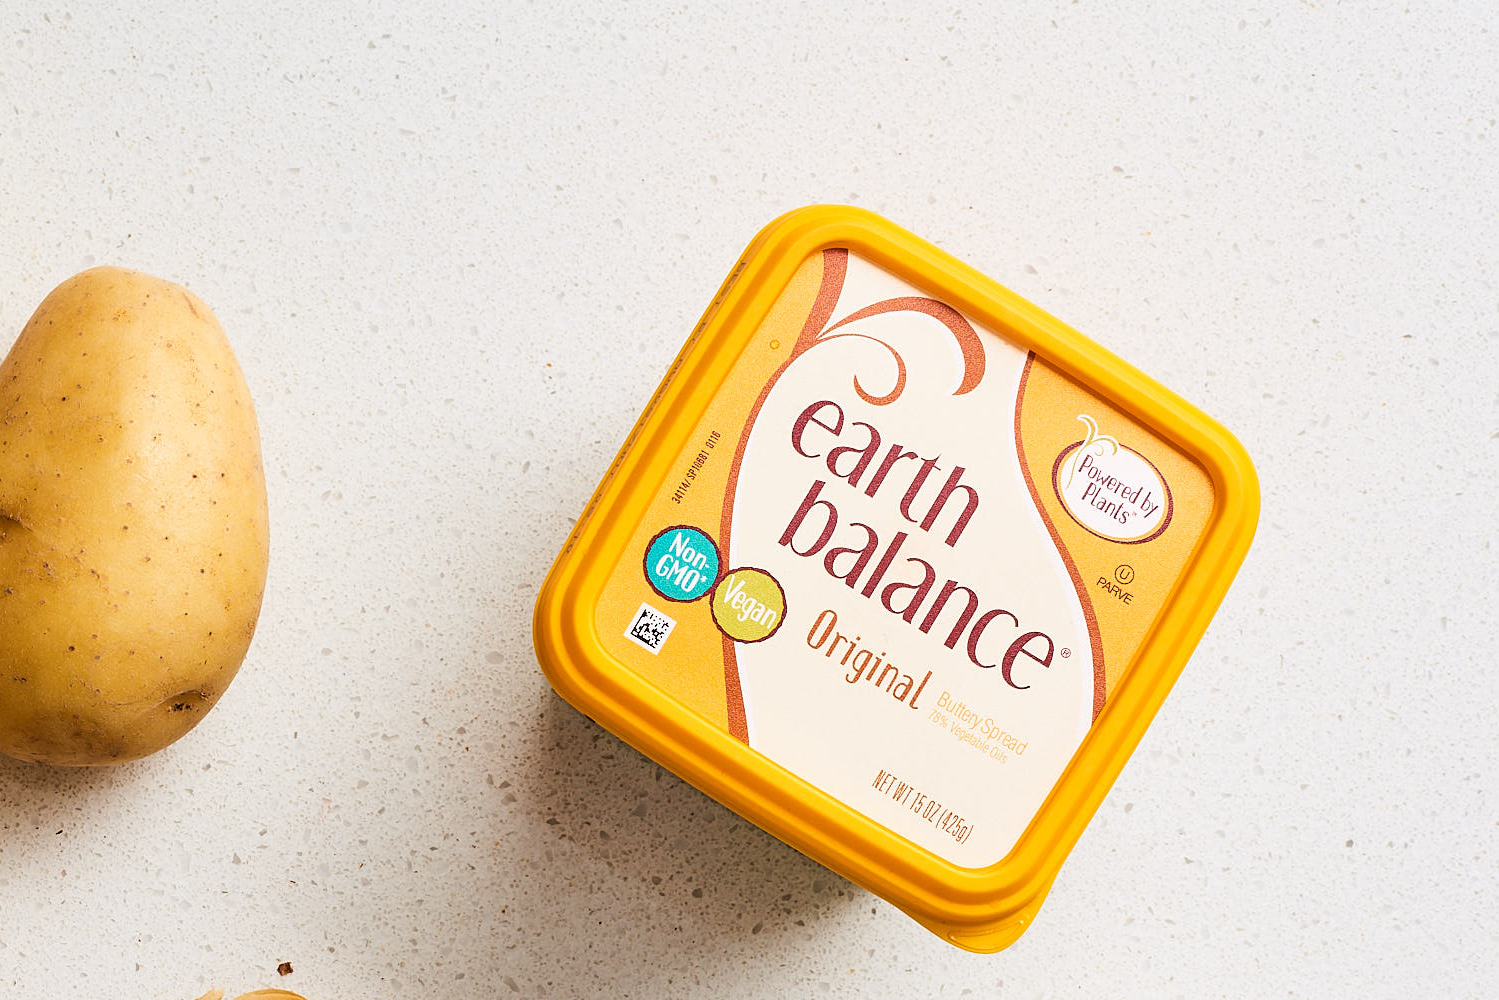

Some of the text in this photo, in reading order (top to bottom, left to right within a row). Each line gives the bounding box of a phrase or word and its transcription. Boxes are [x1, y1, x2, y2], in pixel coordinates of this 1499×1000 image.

[791, 400, 979, 548] earth
[1078, 454, 1159, 519] Powered by
[1081, 481, 1130, 525] Plants
[668, 531, 710, 569] Non-
[723, 575, 777, 629] Vegan
[1096, 576, 1134, 606] PARVE
[806, 609, 933, 710] Original
[936, 691, 1029, 757] Buttery Spread
[872, 769, 898, 795] NET
[892, 781, 914, 805] WT
[935, 808, 975, 845] (425g)
